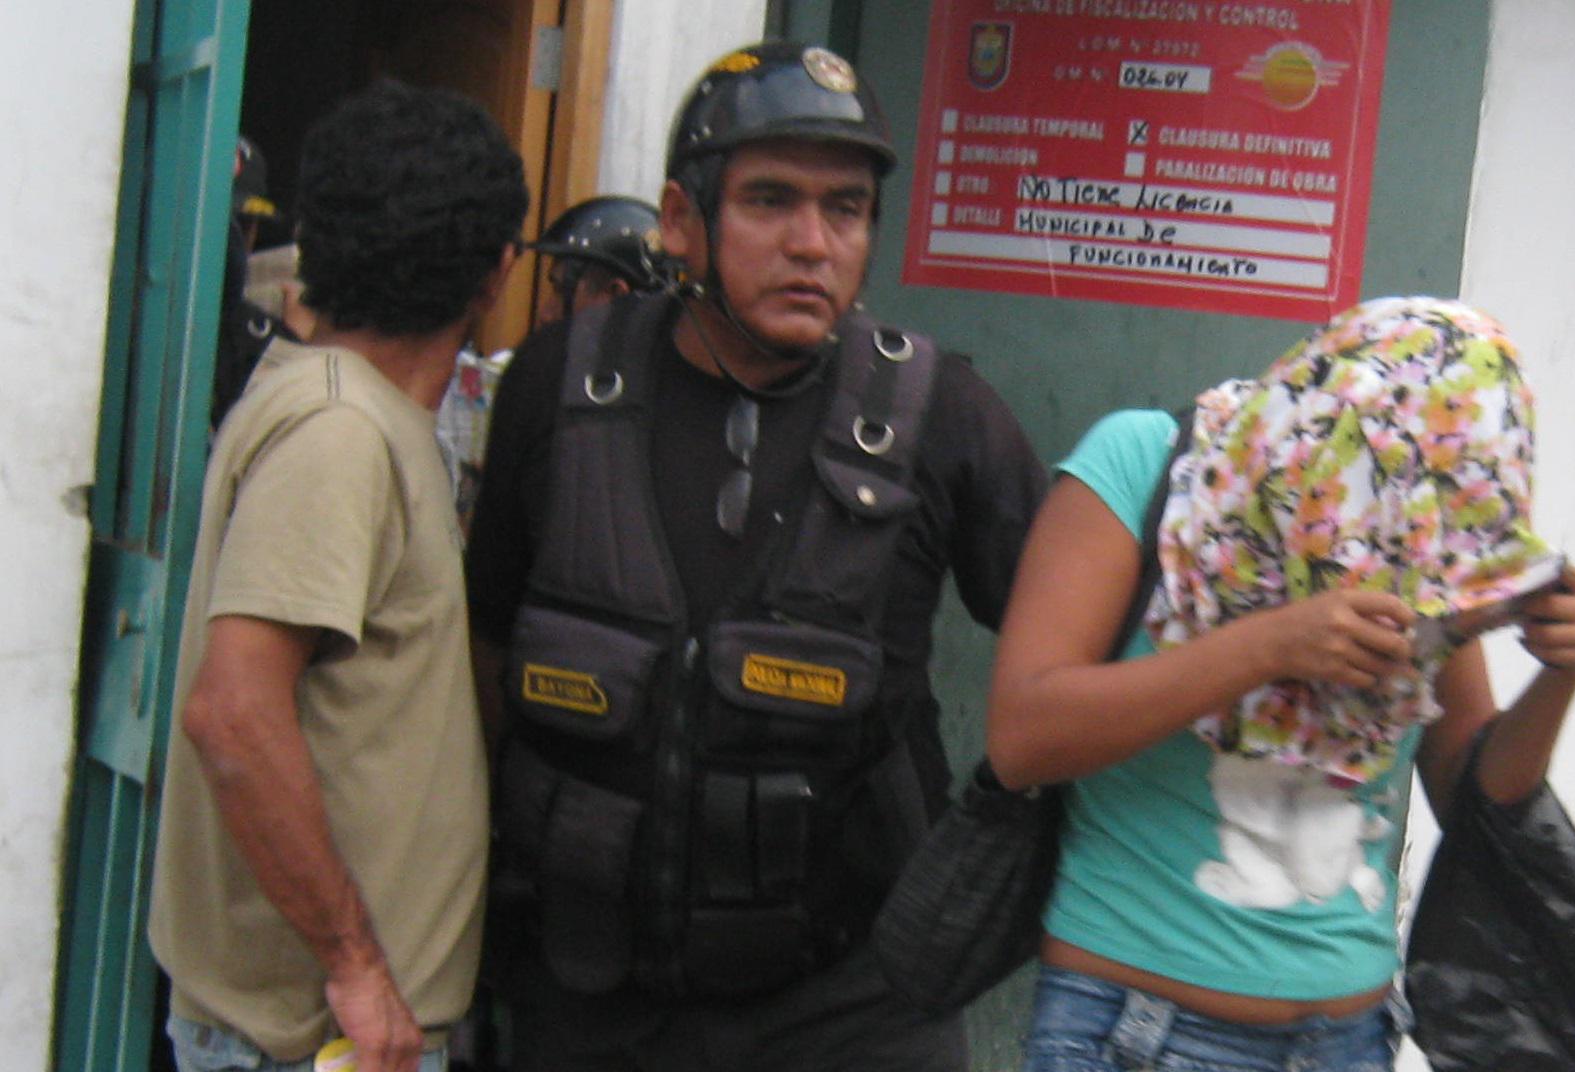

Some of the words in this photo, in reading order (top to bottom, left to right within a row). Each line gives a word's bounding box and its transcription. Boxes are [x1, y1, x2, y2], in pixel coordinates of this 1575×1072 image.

[1219, 5, 1300, 30] CONTROL
[1158, 126, 1240, 150] CLAUSURA
[1243, 132, 1332, 158] DEFINITIVA
[1019, 173, 1051, 201] NO
[1269, 167, 1288, 189] DE
[1292, 171, 1338, 193] OBRA
[1018, 210, 1126, 236] MUNICIPAL
[1068, 245, 1258, 277] FUNCIONAMIENTO
